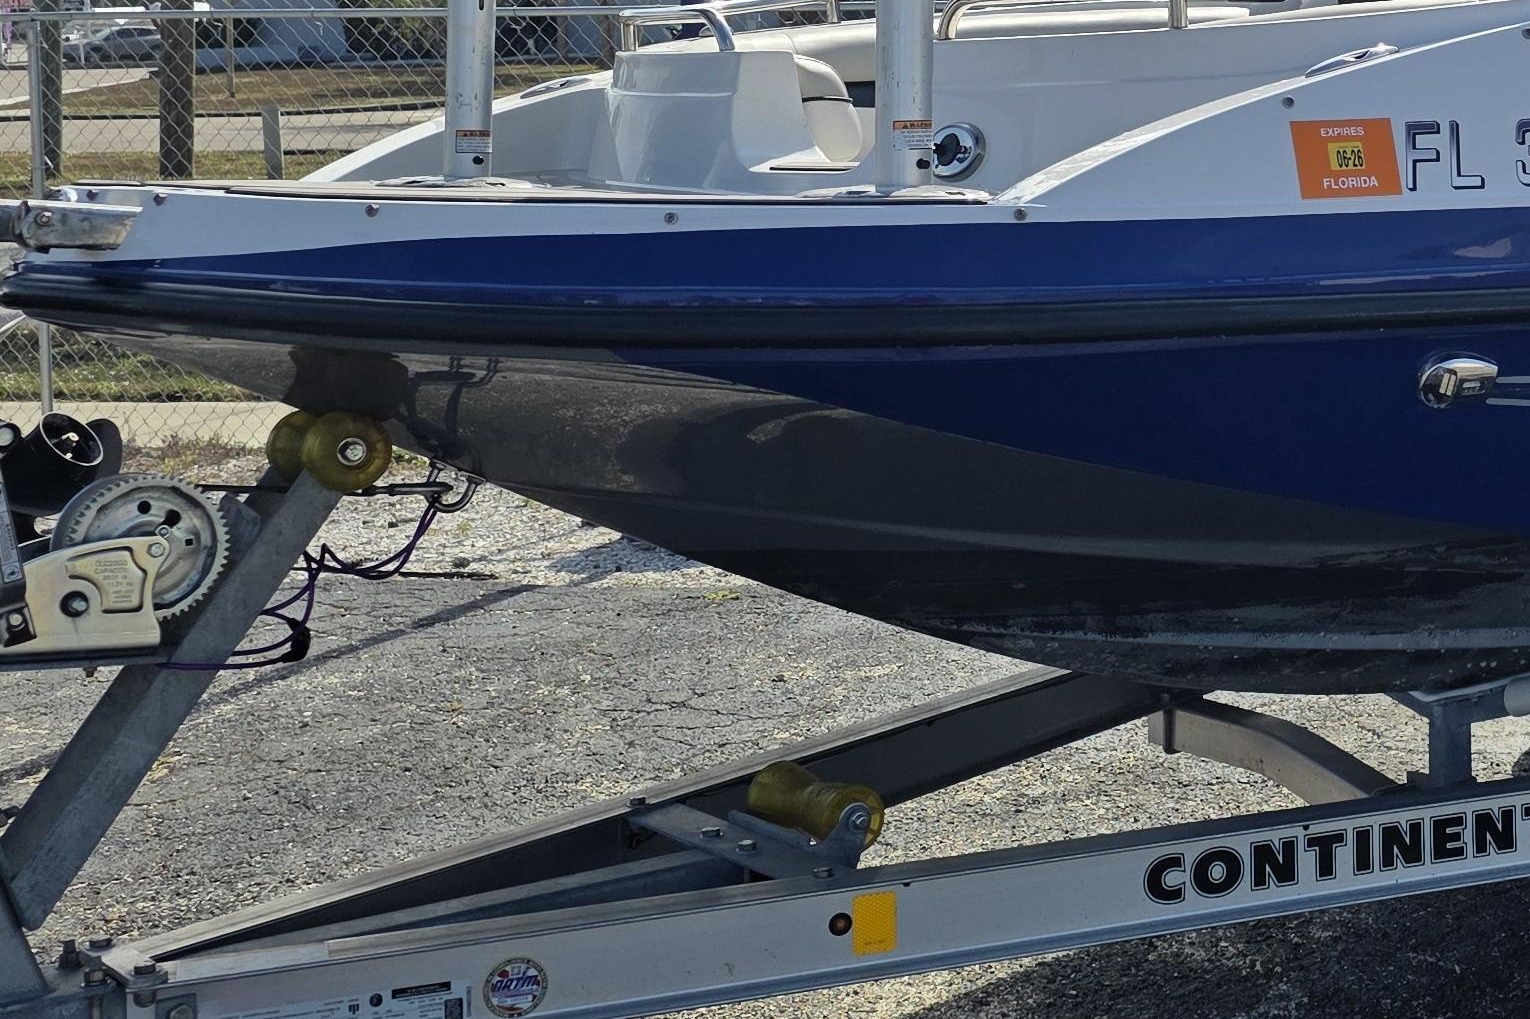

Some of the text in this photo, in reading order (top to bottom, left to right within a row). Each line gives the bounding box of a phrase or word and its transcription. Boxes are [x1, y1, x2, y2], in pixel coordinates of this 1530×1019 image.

[1320, 126, 1365, 137] EXPIRES
[1336, 148, 1364, 168] 06-26
[1404, 120, 1486, 192] FL
[1323, 176, 1379, 190] FLORIDA
